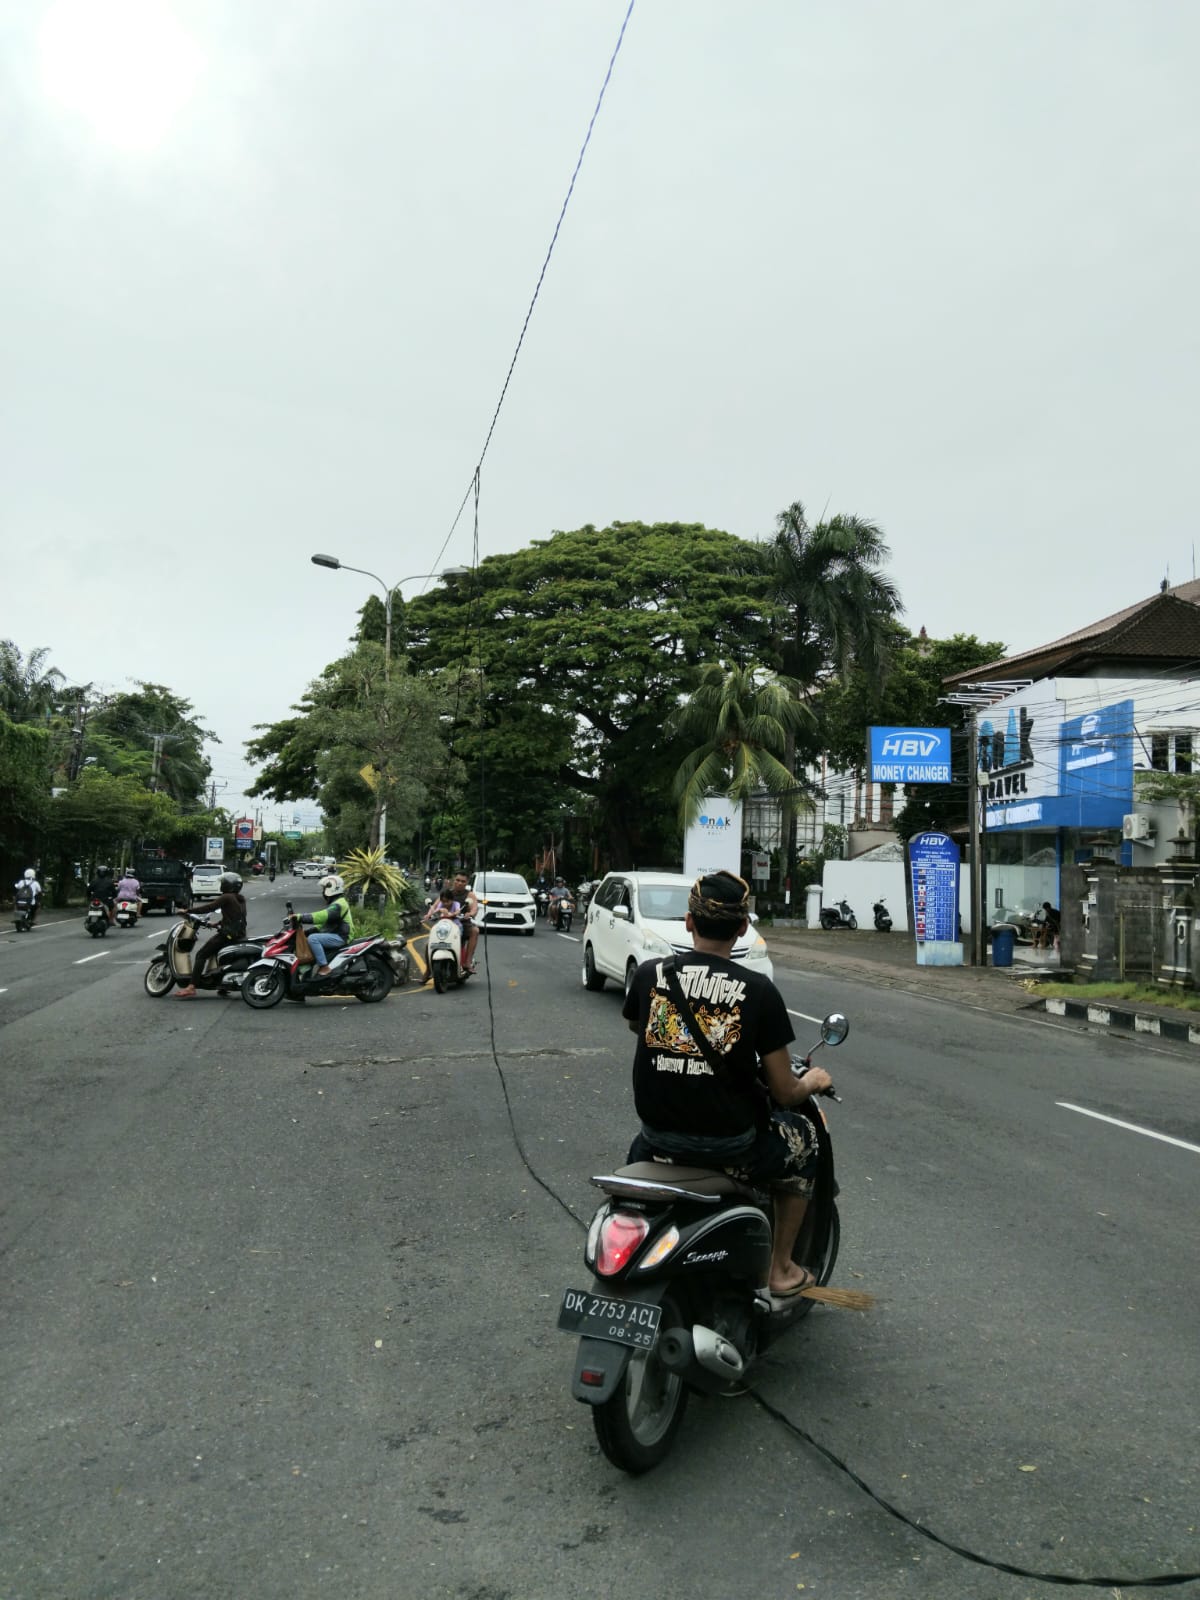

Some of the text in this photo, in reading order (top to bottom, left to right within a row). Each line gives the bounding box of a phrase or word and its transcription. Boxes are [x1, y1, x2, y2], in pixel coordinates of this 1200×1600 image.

[881, 739, 937, 757] HBV
[872, 764, 950, 782] MONEY CHANGER
[919, 836, 947, 846] HBV
[564, 1293, 657, 1329] DK 2753 ACL
